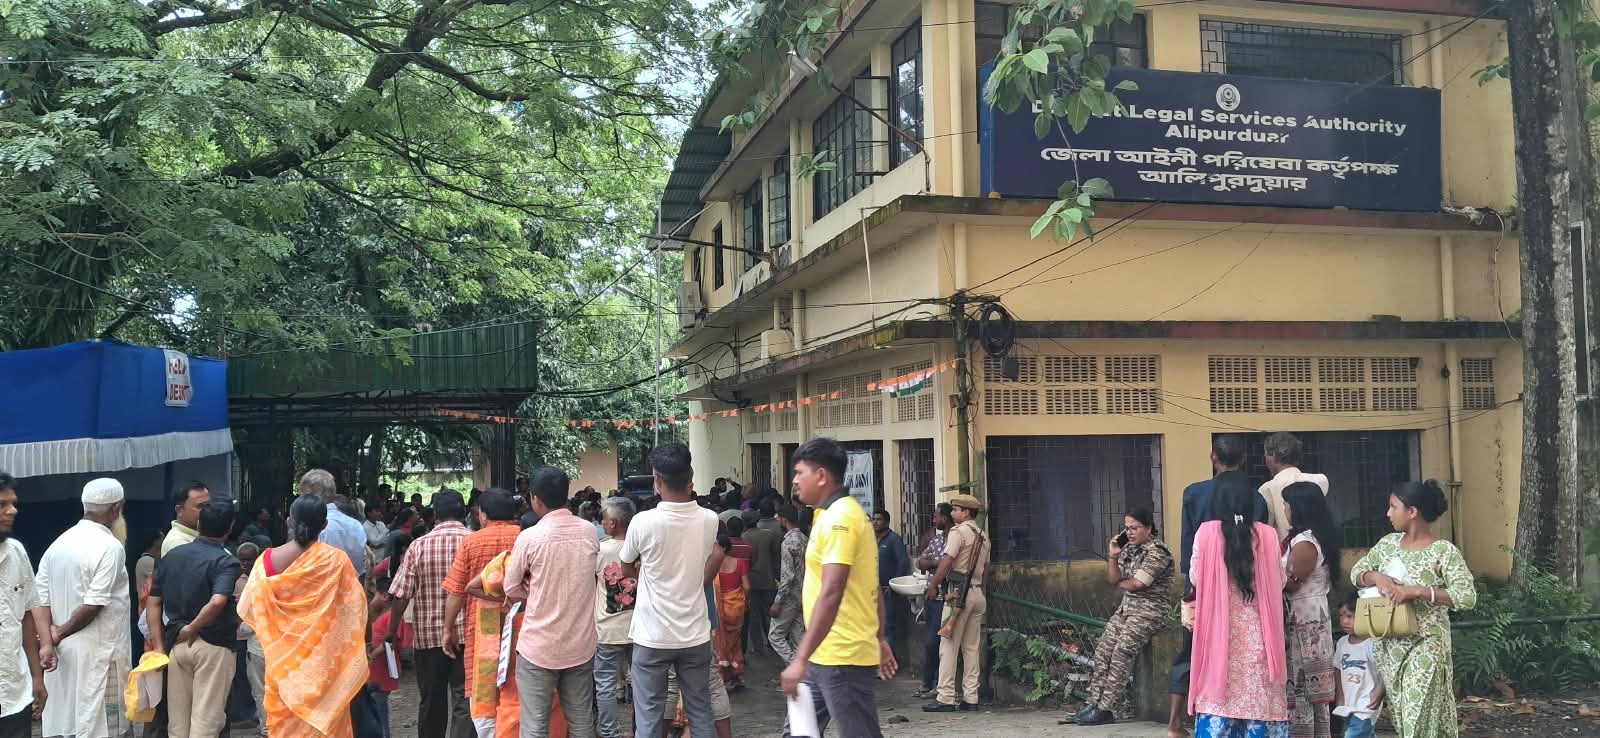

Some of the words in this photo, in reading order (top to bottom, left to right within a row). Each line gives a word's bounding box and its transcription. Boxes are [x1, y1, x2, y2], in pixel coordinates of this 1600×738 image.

[1129, 104, 1194, 122] Legal
[1200, 108, 1297, 127] Services
[1303, 115, 1407, 137] Authority
[1165, 124, 1290, 144] Alipurduar
[1040, 147, 1112, 162] জেলা
[1113, 146, 1198, 166] আইনী
[1201, 150, 1303, 171] পরিষেবা
[1305, 155, 1400, 180] কর্তৃপক্ষ
[1137, 167, 1308, 192] আলিপুরদুয়ার
